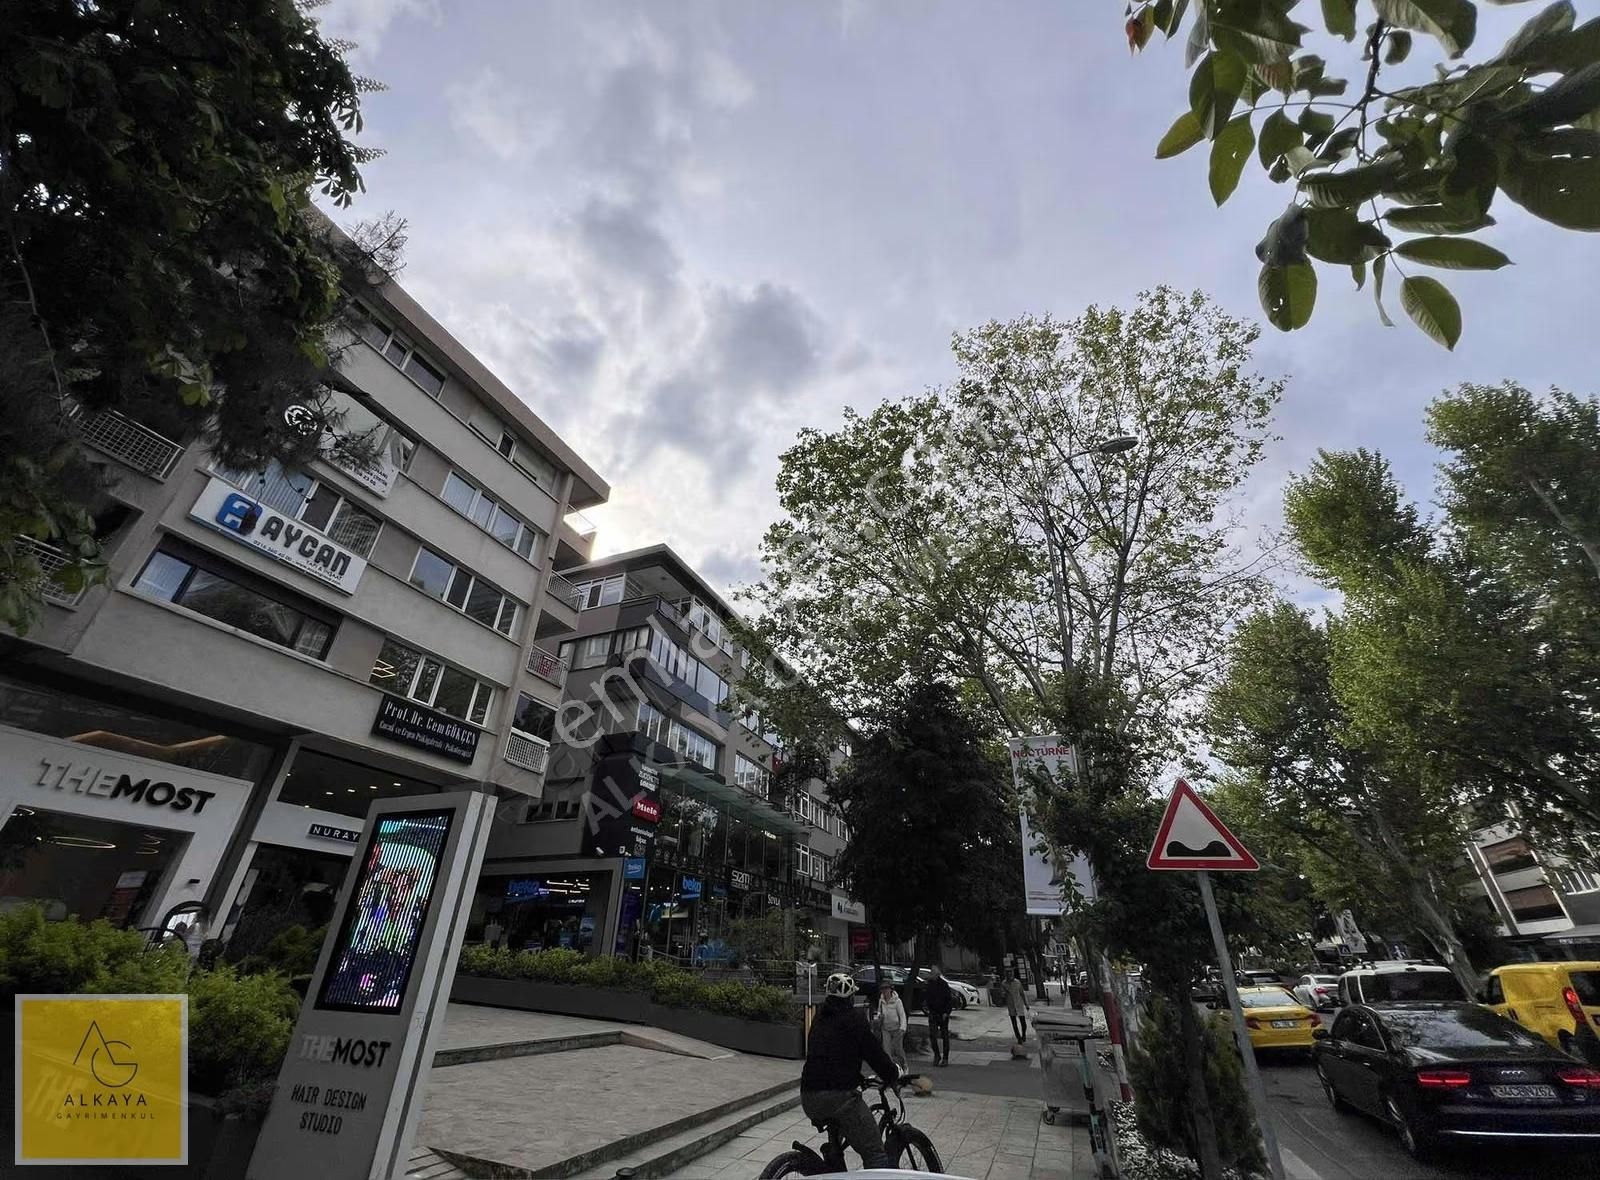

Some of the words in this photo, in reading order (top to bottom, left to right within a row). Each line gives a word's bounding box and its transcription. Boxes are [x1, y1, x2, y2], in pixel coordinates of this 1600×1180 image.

[260, 515, 352, 577] AYCAN
[384, 700, 409, 722] Prof.
[410, 710, 424, 728] Dr.
[426, 716, 445, 735] Cem
[636, 802, 658, 816] Miele
[312, 825, 359, 842] NURAY
[682, 875, 702, 892] beko
[291, 1084, 320, 1104] HAIR
[324, 1088, 367, 1110] DESIGN
[299, 1112, 343, 1135] STUDIO
